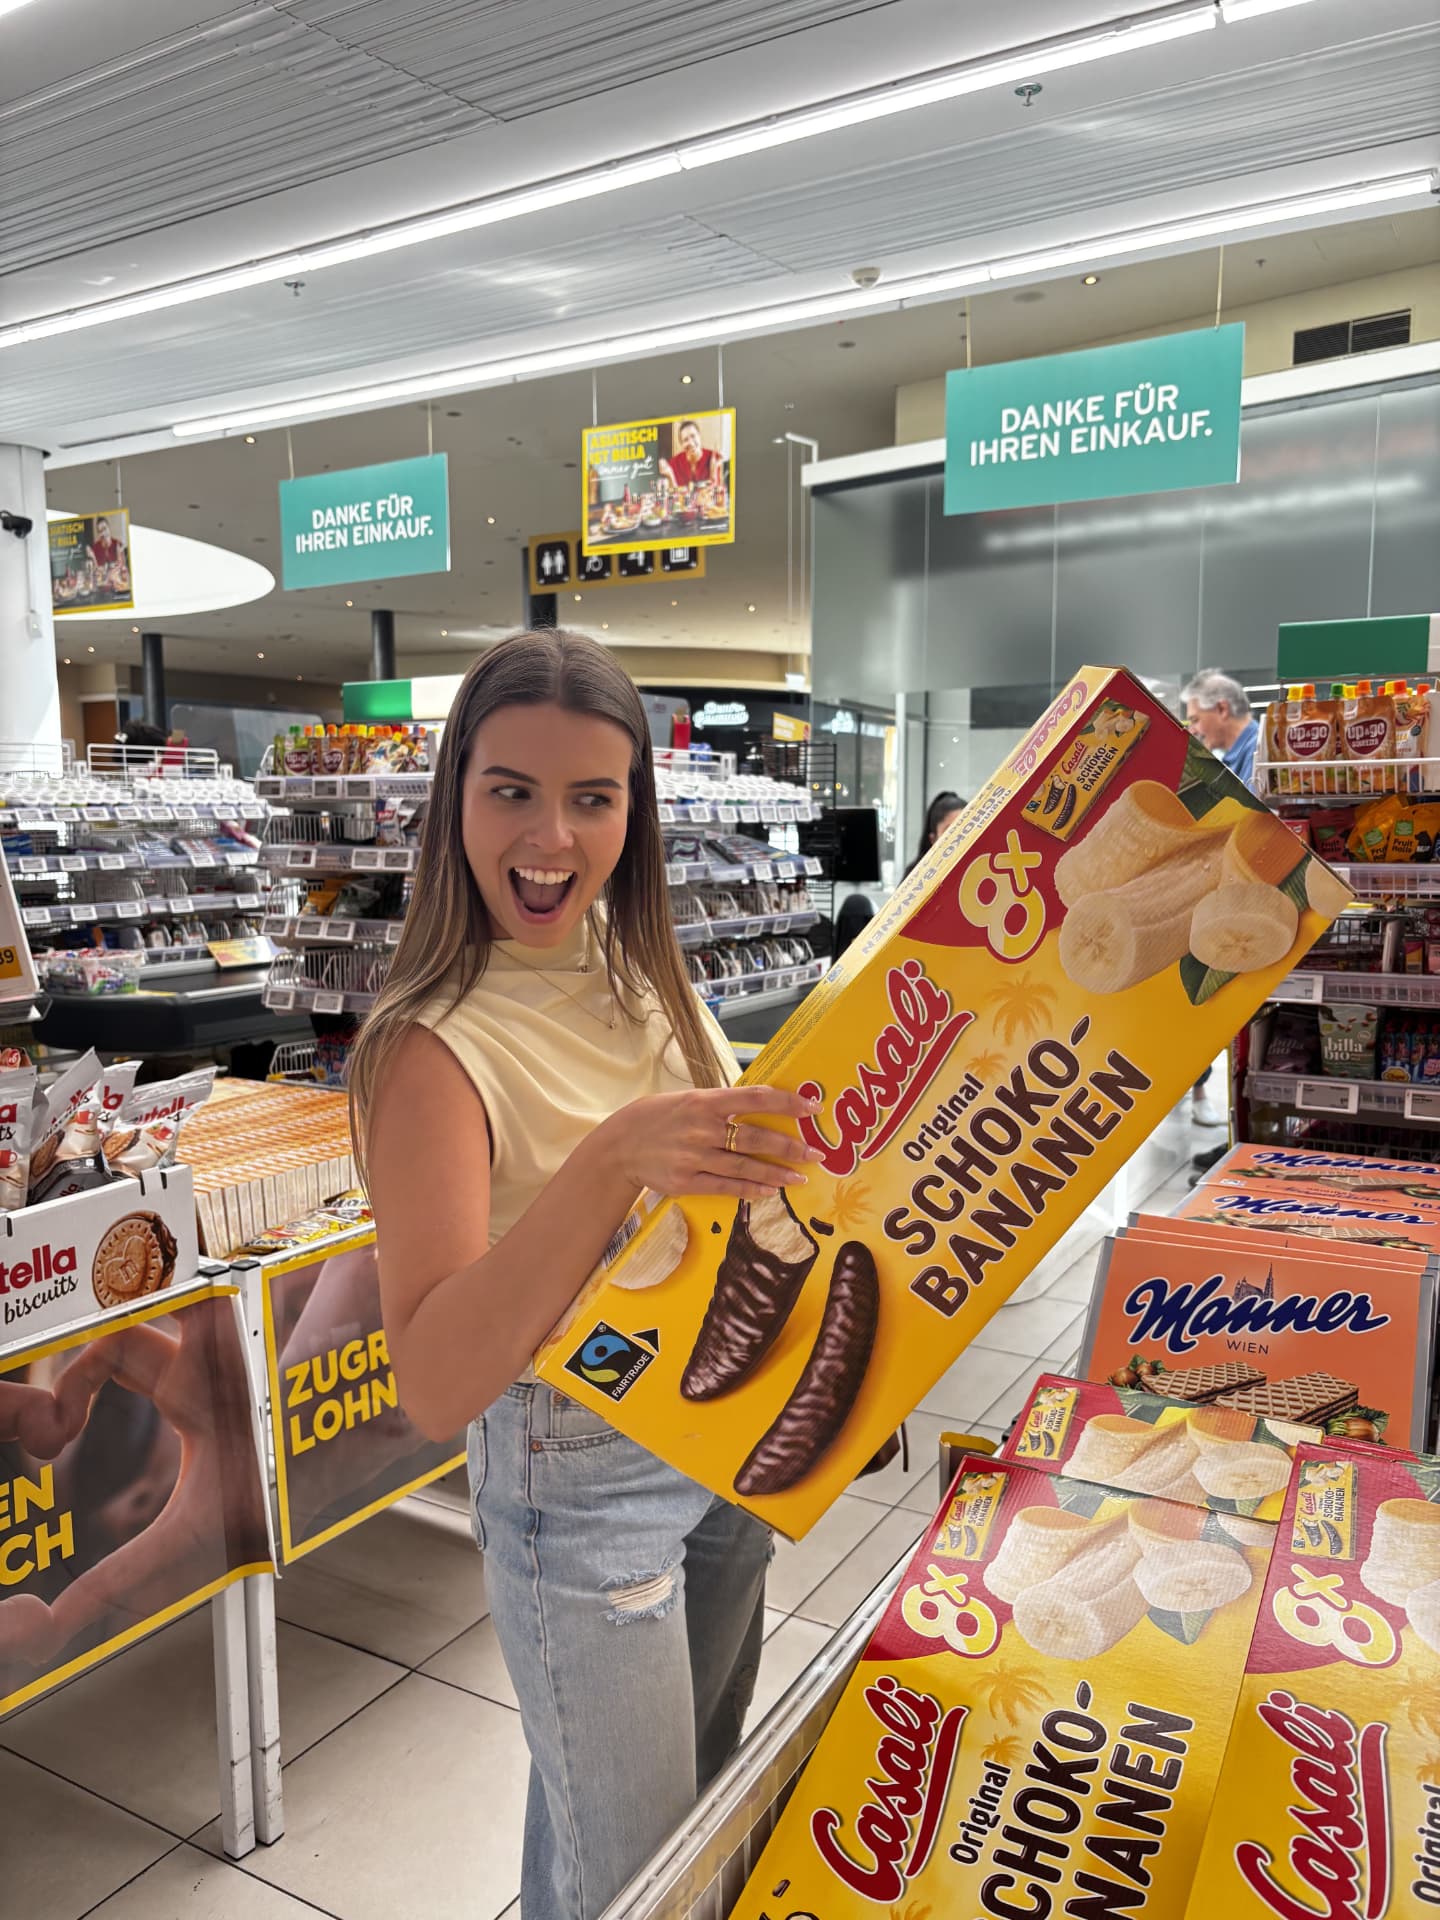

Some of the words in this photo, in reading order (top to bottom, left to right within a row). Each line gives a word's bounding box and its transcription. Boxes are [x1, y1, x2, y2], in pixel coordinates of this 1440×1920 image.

[1001, 395, 1105, 434] DANKE
[1115, 382, 1179, 419] FÜR
[612, 445, 645, 462] BILLA
[970, 431, 1060, 467] IHREN
[1071, 410, 1213, 454] EINKAUF.
[295, 527, 348, 554] IHREN
[353, 515, 433, 546] EINKAUF.
[312, 501, 372, 530] DANKE
[376, 493, 413, 520] FÜR
[1008, 681, 1088, 778] Casali
[1061, 740, 1088, 774] Casali
[1076, 743, 1107, 784] SCHOKO-
[1082, 746, 1119, 792] BANANEN
[959, 829, 1047, 960] 8x
[797, 958, 976, 1176] Casali
[1326, 1037, 1363, 1053] billa
[882, 1014, 1090, 1257] SCHOKO-
[902, 1072, 985, 1163] Original
[910, 1049, 1153, 1318] BANANEN
[1252, 1152, 1440, 1175] Manner
[1212, 1194, 1436, 1226] Manner
[4, 1275, 79, 1325] biscuits
[1123, 1273, 1392, 1355] Manner
[1226, 1338, 1270, 1355] WIEN
[611, 1352, 651, 1398] FAIRTRADE
[1323, 1486, 1336, 1519] SCHOKO-
[1334, 1487, 1345, 1522] BANANEN
[901, 1563, 998, 1656] 8x
[1272, 1563, 1398, 1669] 8x
[810, 1675, 971, 1905] Casali
[948, 1760, 1012, 1865] Original
[974, 1680, 1108, 1920] CHOKO-
[1233, 1690, 1389, 1920] Casali
